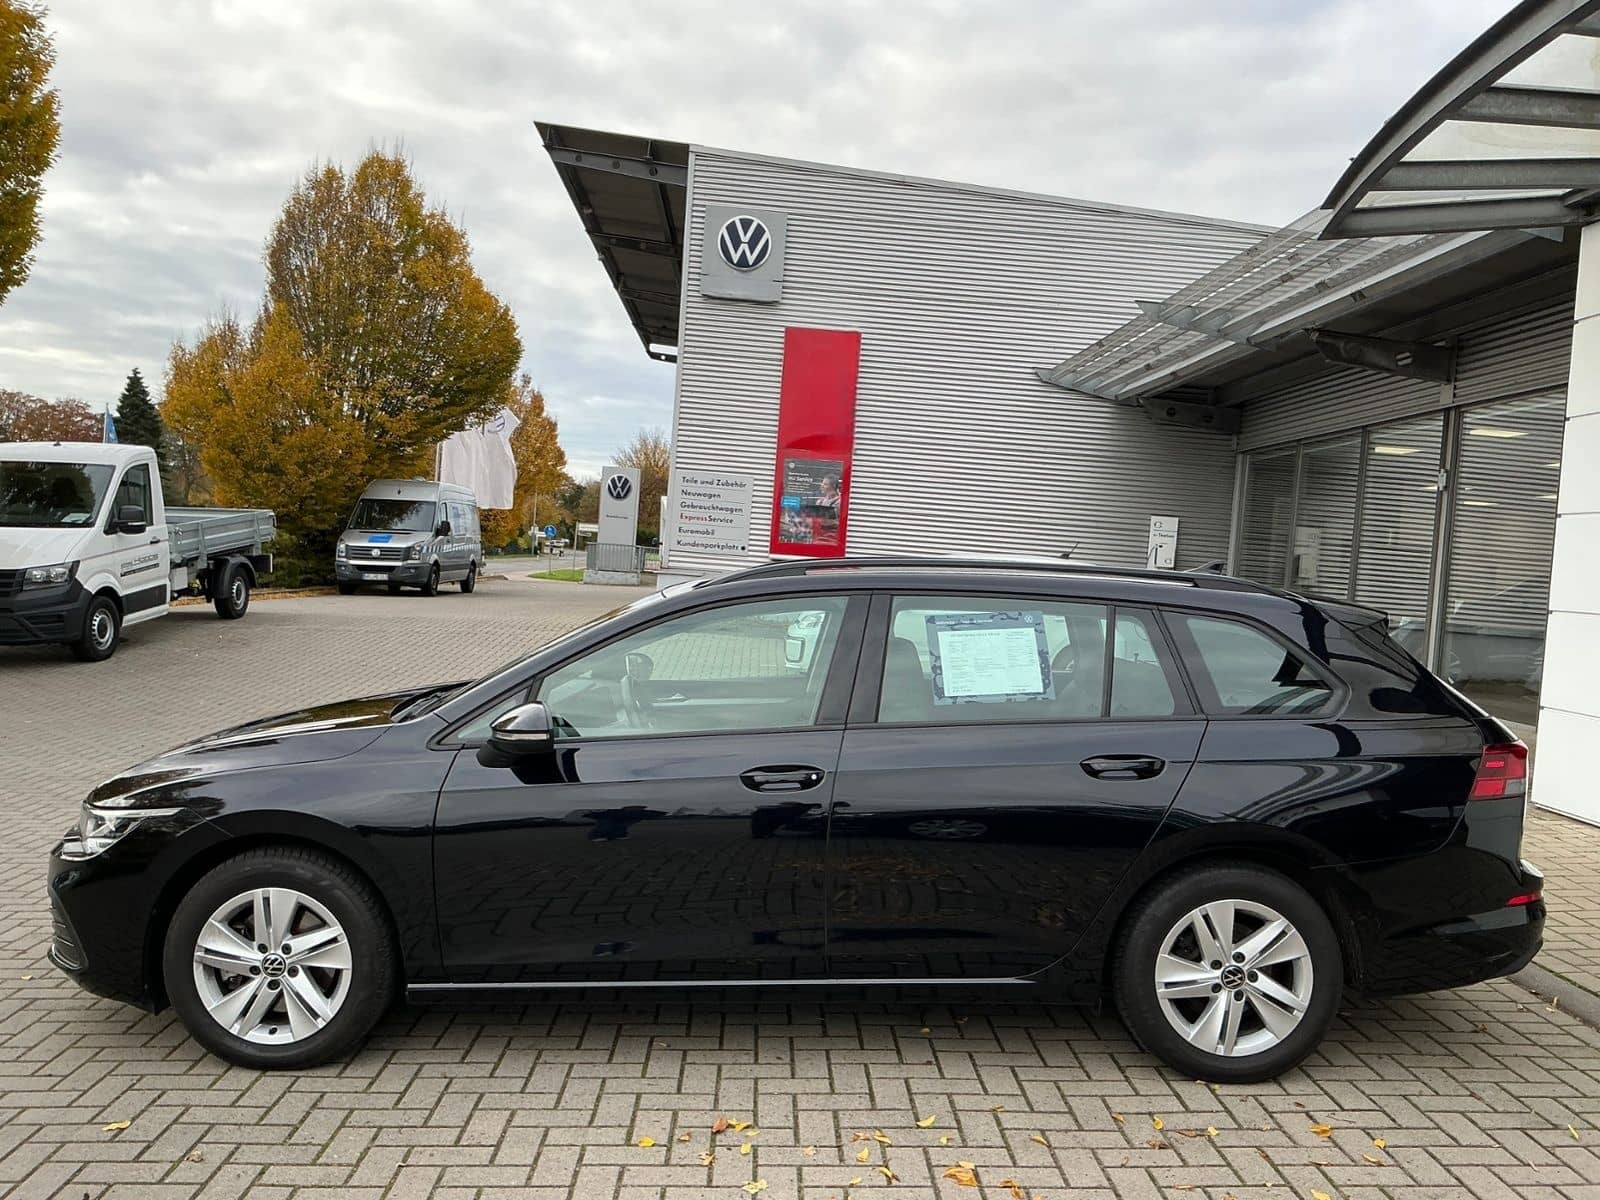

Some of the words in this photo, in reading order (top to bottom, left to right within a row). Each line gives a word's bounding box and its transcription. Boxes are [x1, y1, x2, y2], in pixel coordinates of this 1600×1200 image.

[719, 216, 771, 270] VW
[607, 474, 632, 500] VW
[716, 479, 747, 488] Zubehör
[681, 489, 721, 499] Neuwagen
[680, 501, 743, 513] Gebrauchtwagen
[678, 527, 715, 536] Euromobil
[677, 540, 739, 551] Kundenparkplatz
